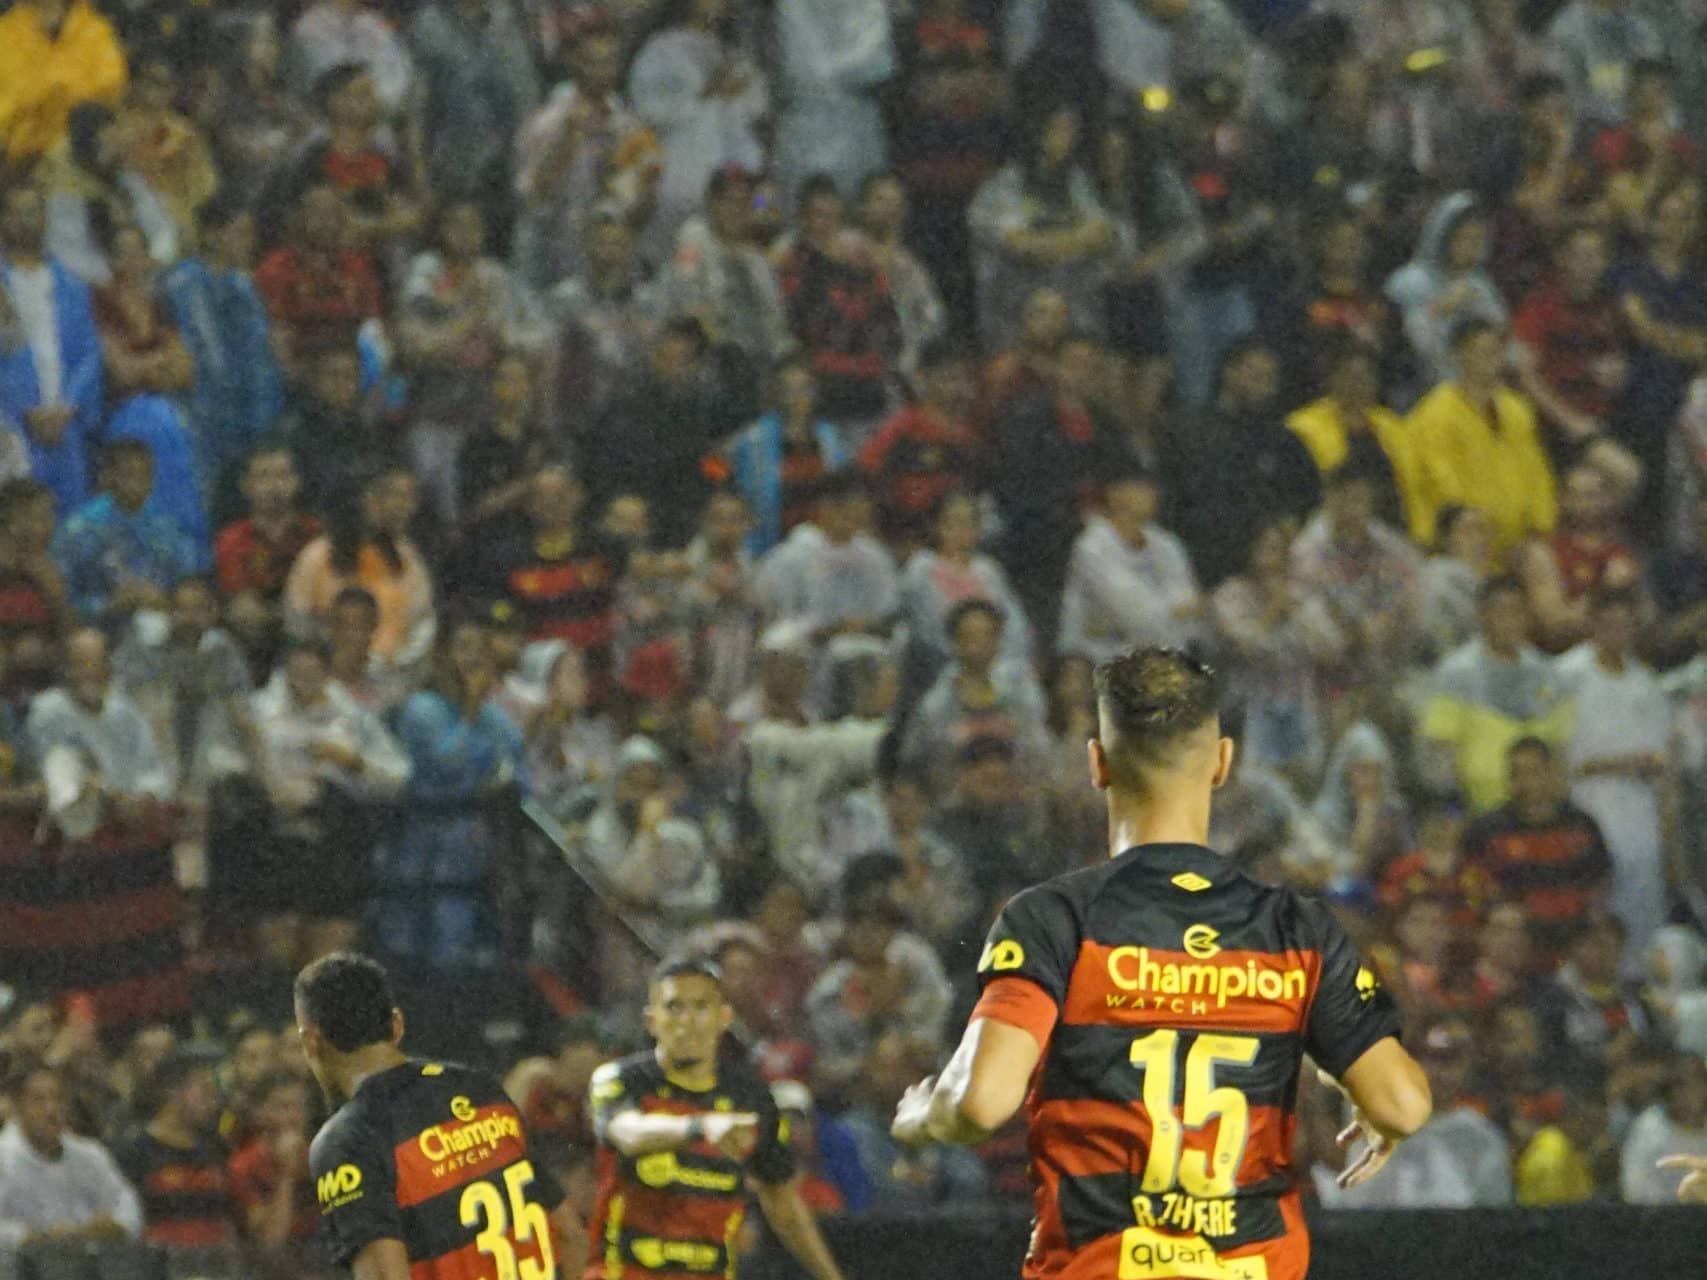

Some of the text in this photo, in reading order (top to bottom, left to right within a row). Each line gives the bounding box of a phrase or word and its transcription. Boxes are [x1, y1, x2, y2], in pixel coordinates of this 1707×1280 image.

[1107, 945, 1306, 1009] Champion
[1105, 993, 1208, 1016] WATCH
[1130, 1028, 1260, 1197] 15
[431, 1146, 490, 1178] WATCH
